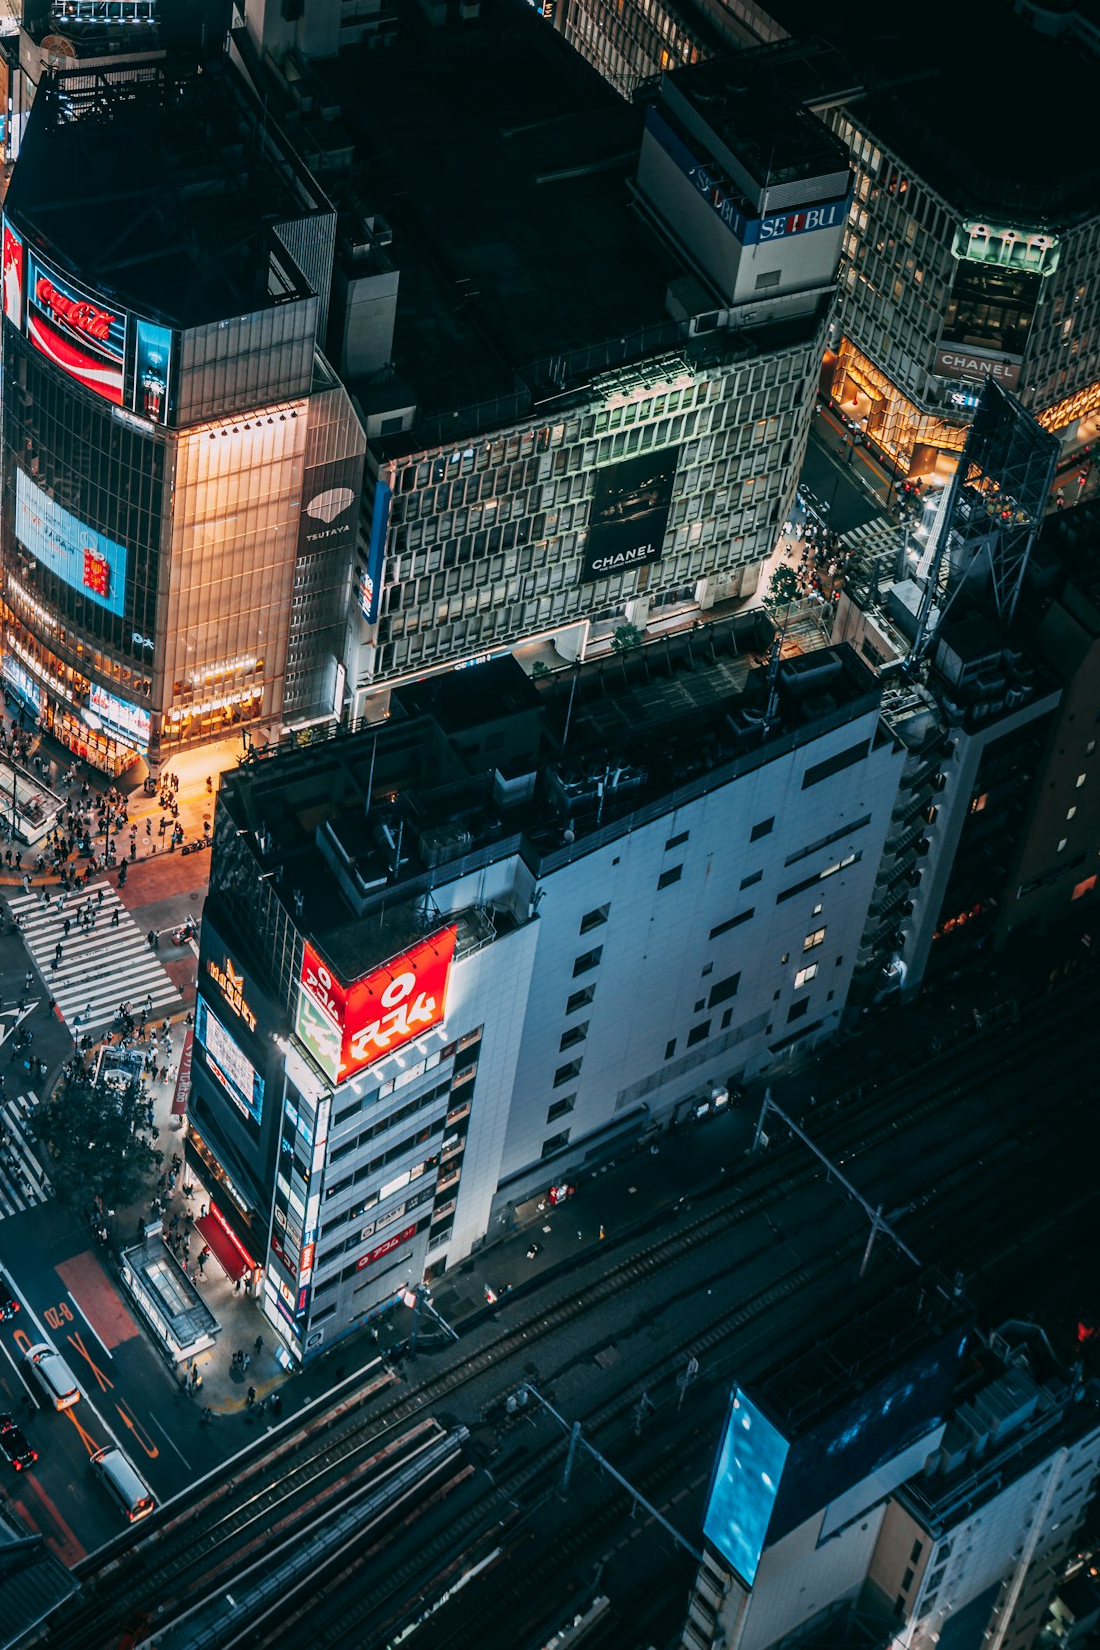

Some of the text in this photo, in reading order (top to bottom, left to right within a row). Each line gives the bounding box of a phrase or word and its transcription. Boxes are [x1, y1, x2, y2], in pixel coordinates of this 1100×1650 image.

[759, 205, 836, 239] SEIBU
[941, 354, 1014, 378] CHANEL
[305, 524, 351, 542] TSUTAYA
[591, 543, 656, 570] CHANEL
[351, 990, 437, 1061] アコム
[403, 1227, 414, 1240] 3F
[373, 1238, 400, 1258] アコム
[43, 1301, 75, 1330] 8-20
